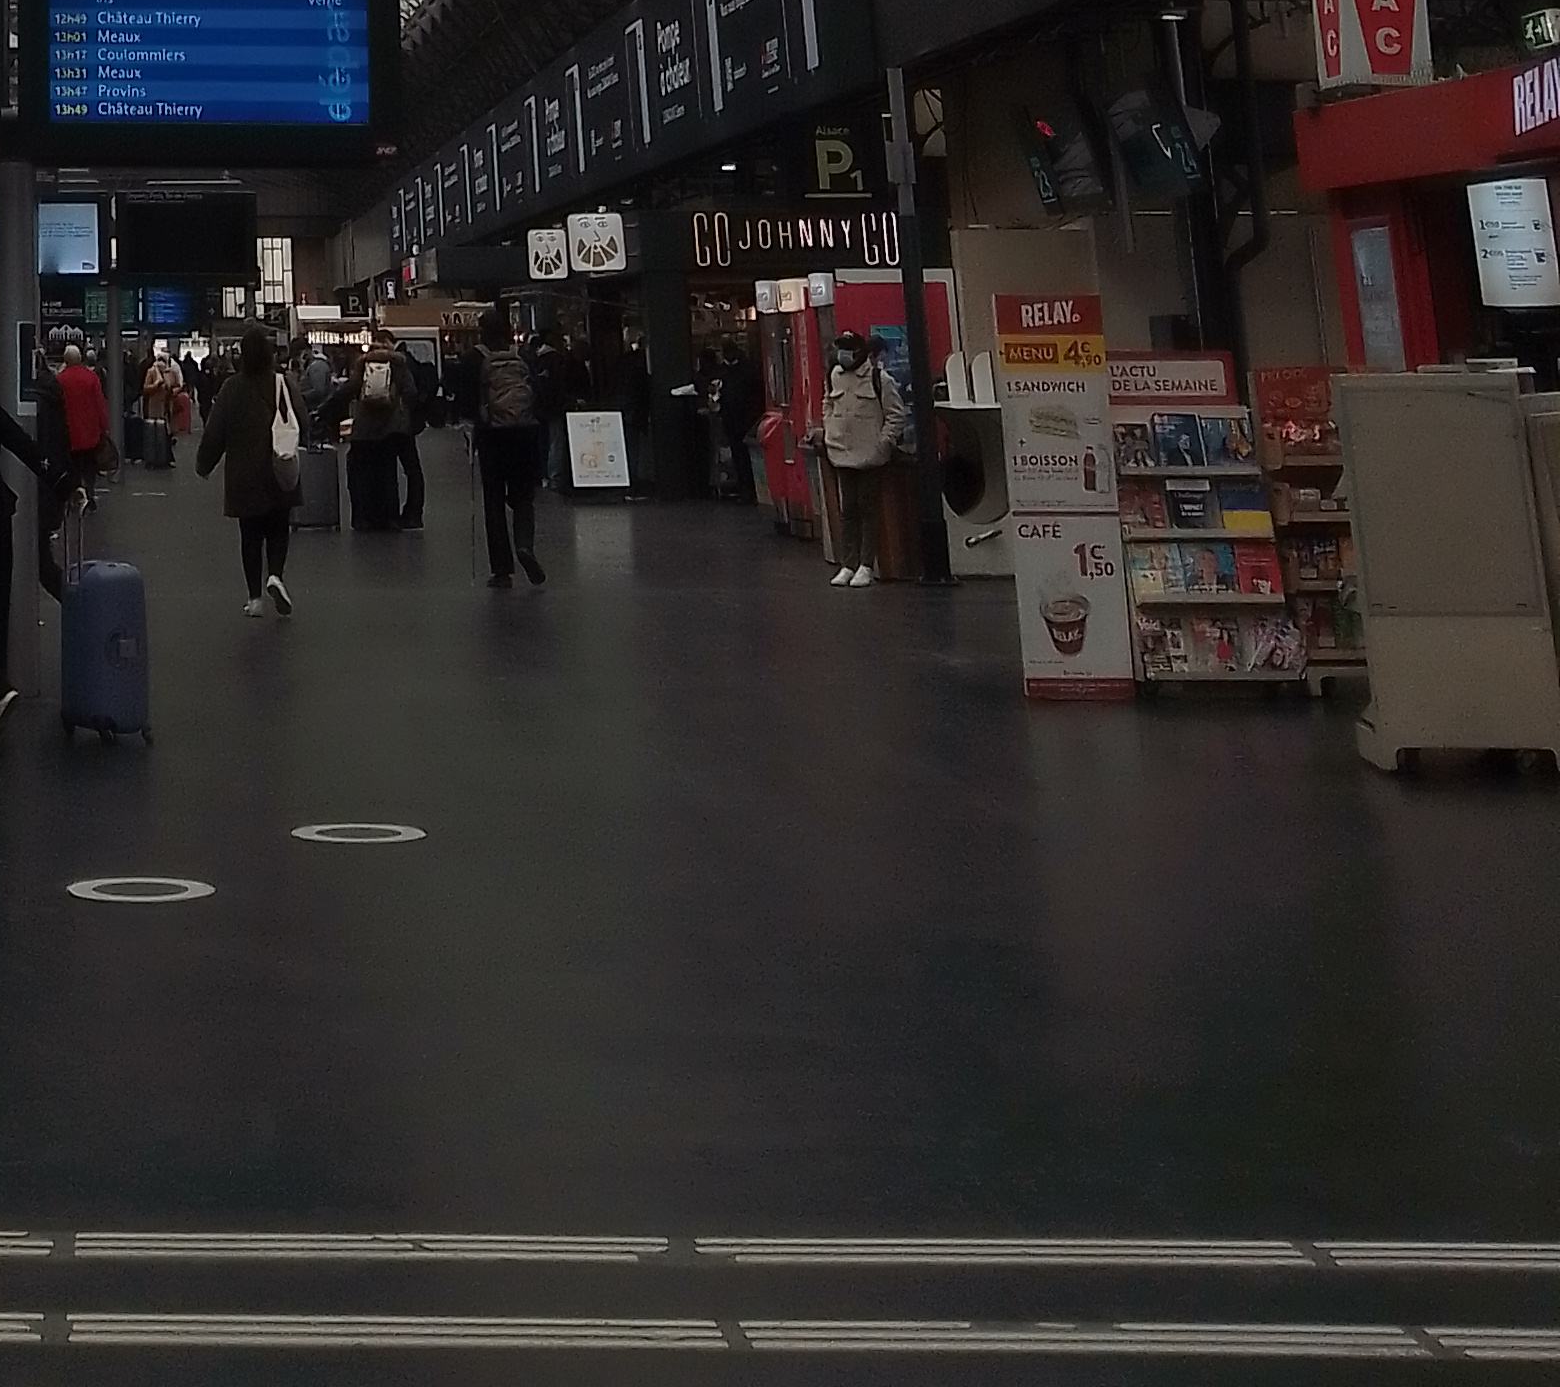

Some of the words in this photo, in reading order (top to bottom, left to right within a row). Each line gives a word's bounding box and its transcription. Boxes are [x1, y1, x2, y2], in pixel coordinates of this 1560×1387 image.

[97, 11, 154, 26] Château
[155, 11, 203, 28] Thierry
[54, 30, 88, 44] 13h01
[97, 29, 142, 44] Meaux
[97, 47, 187, 63] Coulommiers
[54, 66, 89, 81] 13h31
[97, 65, 143, 80] Meaux
[98, 83, 148, 100] Provins
[54, 102, 90, 117] 13h49
[97, 101, 154, 117] Château
[156, 101, 204, 119] Thierry
[815, 124, 851, 137] Alsace
[737, 217, 853, 251] JOHNNY
[1020, 299, 1075, 329] RELAY
[1009, 346, 1055, 361] MENU
[1109, 365, 1157, 378] L'ACTU
[1015, 380, 1087, 393] SANDWICH
[1112, 379, 1131, 392] DE
[1134, 379, 1152, 391] LA
[1155, 379, 1218, 392] SEMAINE
[1020, 455, 1079, 467] BOISSON
